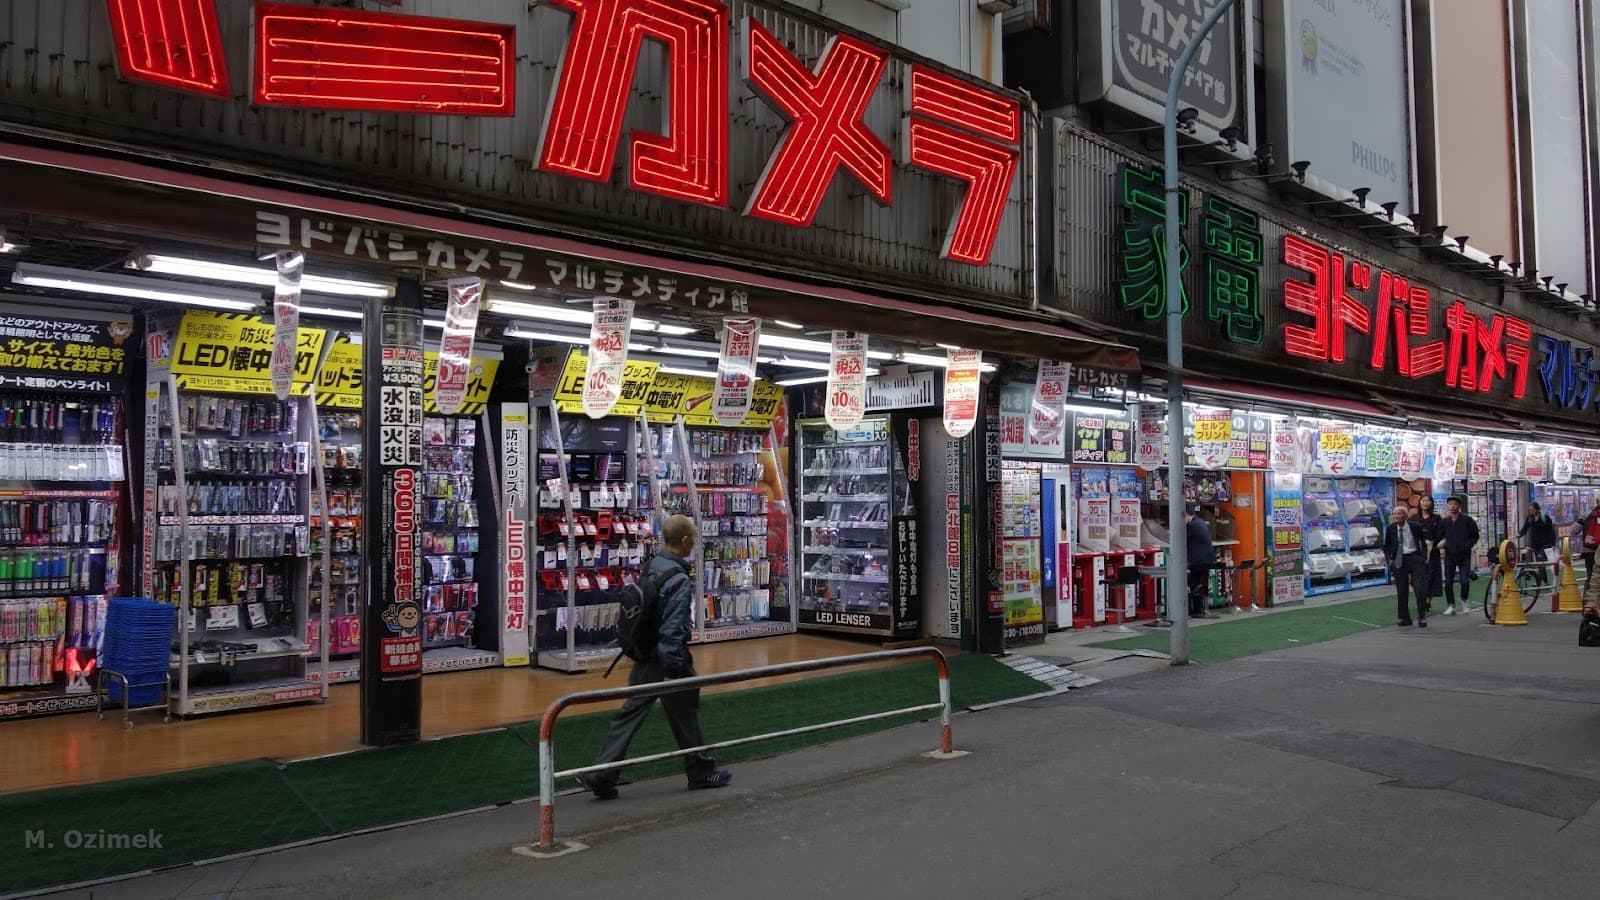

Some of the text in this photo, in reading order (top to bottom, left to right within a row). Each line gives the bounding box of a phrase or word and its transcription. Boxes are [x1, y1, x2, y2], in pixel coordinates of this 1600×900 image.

[1350, 139, 1397, 183] PHILIPS
[256, 210, 525, 281] ヨドバシカメラ
[1119, 163, 1264, 346] 家電
[1283, 233, 1532, 399] ヨドバシカメラ
[177, 341, 315, 376] LED懐中灯
[594, 333, 623, 352] 税込
[835, 358, 862, 375] 税込
[383, 388, 403, 424] 水没
[1040, 382, 1064, 396] 税込
[1196, 430, 1231, 440] プリント
[1200, 421, 1227, 431] セルフ
[383, 428, 403, 463] 火災
[1321, 441, 1353, 450] プリント
[505, 428, 519, 508] 防災グッズ!
[394, 469, 415, 603] 365日間補償
[507, 510, 525, 630] LED懐中電灯
[816, 611, 872, 627] LED LENSER
